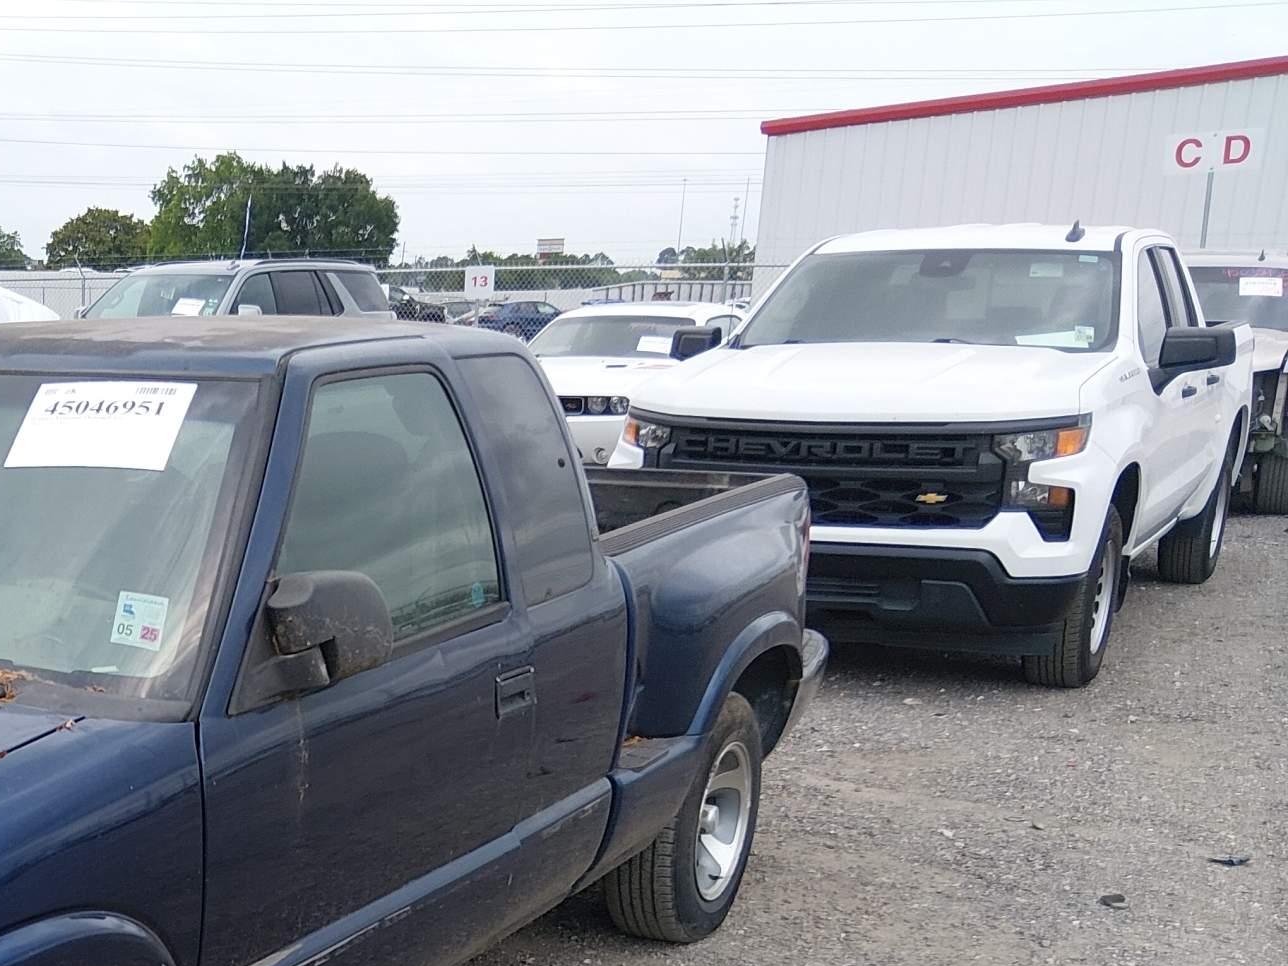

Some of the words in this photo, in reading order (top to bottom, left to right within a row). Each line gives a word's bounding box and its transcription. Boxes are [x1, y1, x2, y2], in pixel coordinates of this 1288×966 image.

[1175, 138, 1203, 168] C
[1223, 135, 1251, 164] D
[472, 276, 488, 287] 13
[43, 400, 166, 416] 45046951
[675, 434, 978, 461] CHEVROLET
[117, 623, 133, 636] 05
[140, 626, 158, 642] 25
